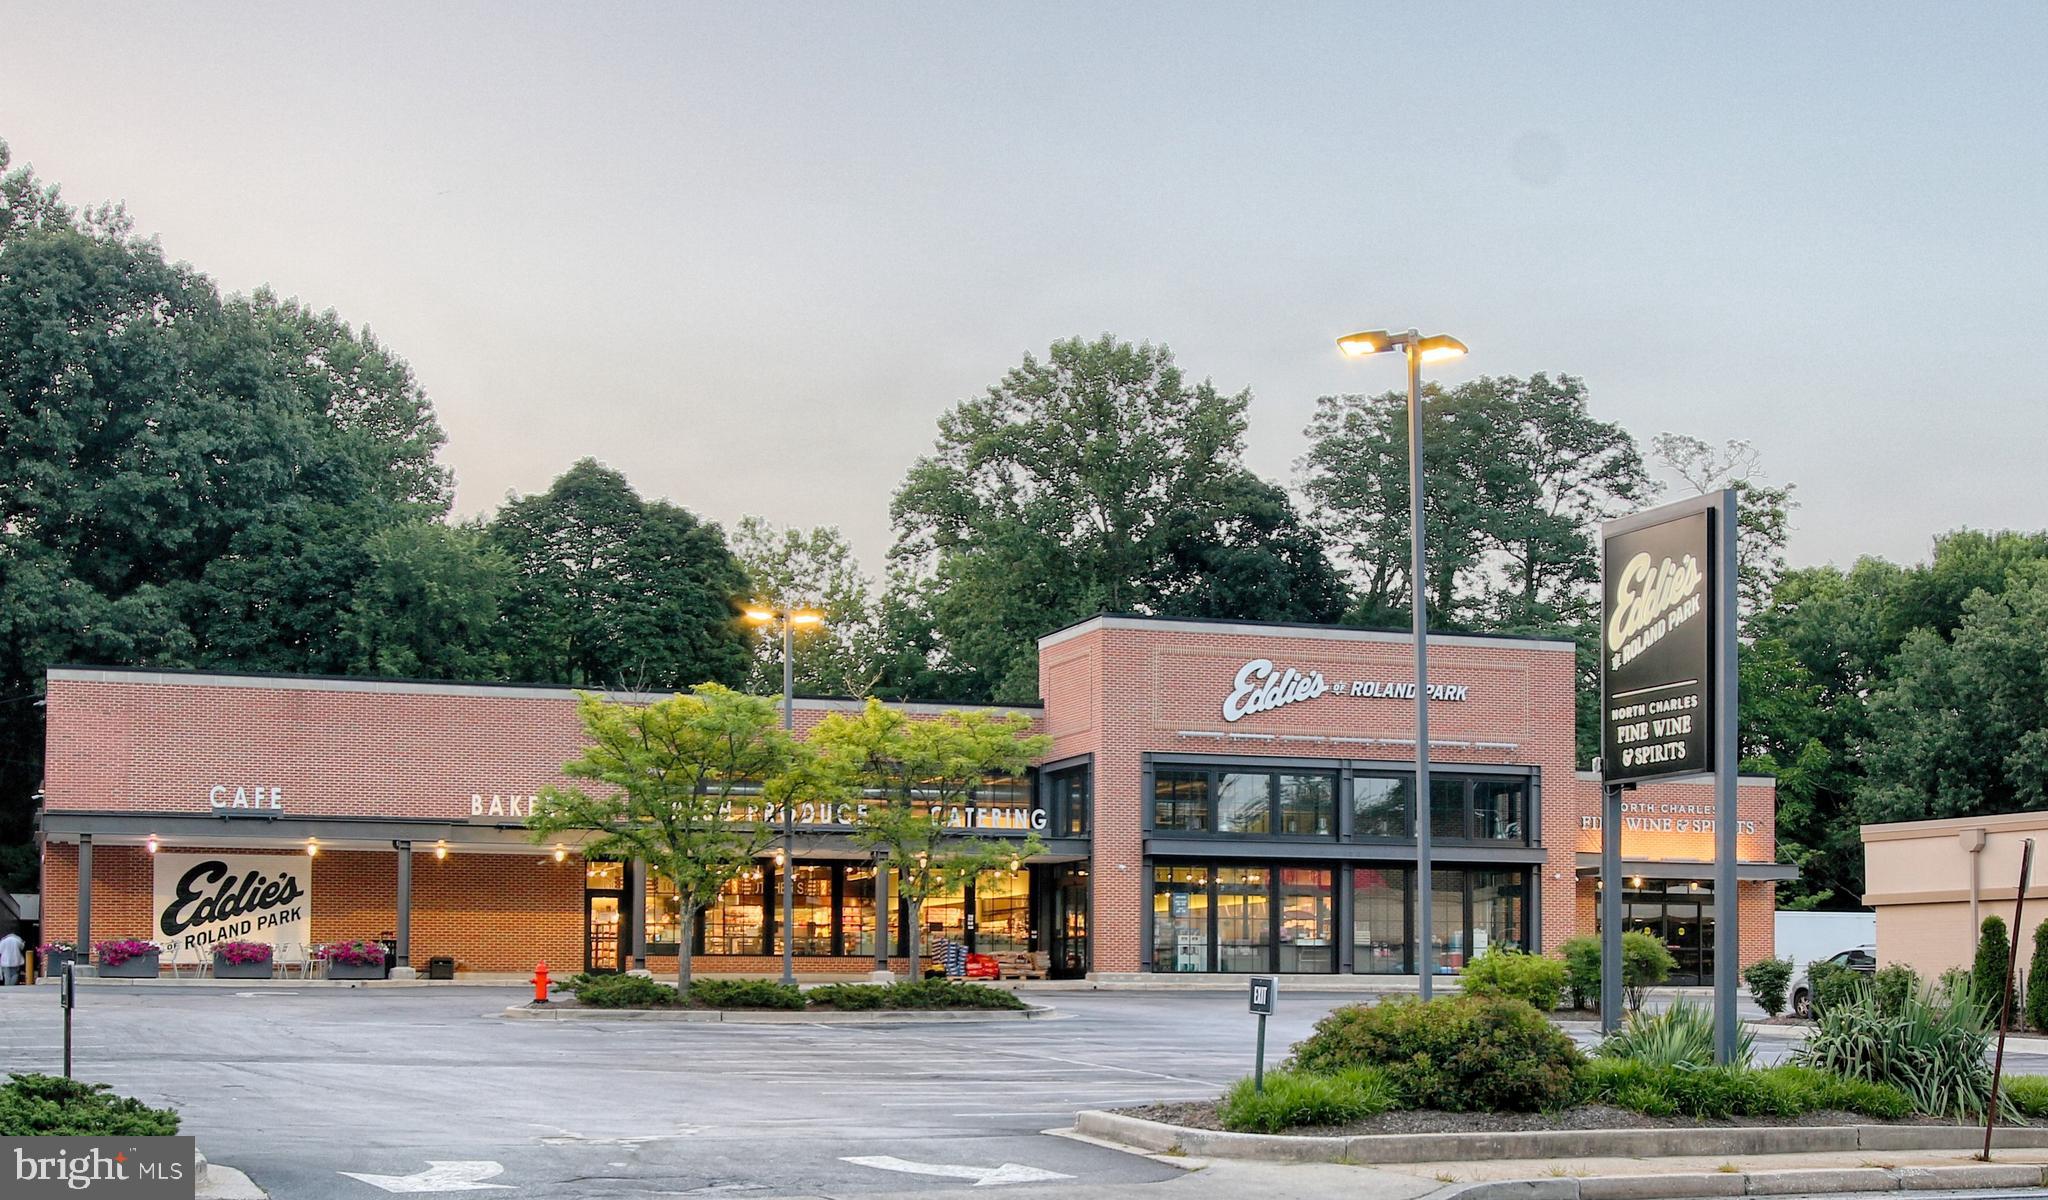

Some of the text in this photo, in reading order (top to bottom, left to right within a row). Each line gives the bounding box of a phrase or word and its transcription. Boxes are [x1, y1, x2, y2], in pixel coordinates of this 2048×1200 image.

[1607, 552, 1702, 652] Eddie's
[1622, 618, 1666, 665] ROLAND
[1667, 593, 1700, 632] PARK
[1223, 658, 1329, 722] Eddie's
[1350, 681, 1416, 699] ROLAND
[1426, 685, 1468, 701] PARK
[1611, 695, 1698, 721] NORTH CHARLES
[1616, 715, 1692, 744] FINE WINE
[1635, 741, 1686, 765] SPIRITS
[210, 785, 281, 809] CAFE
[1620, 802, 1655, 812] ORTH
[931, 806, 1048, 829] CATERING
[1627, 818, 1671, 832] WINE
[1692, 820, 1755, 835] SPITS
[160, 860, 305, 937] Eddie's
[185, 920, 251, 950] ROLAND
[257, 907, 301, 931] PARK
